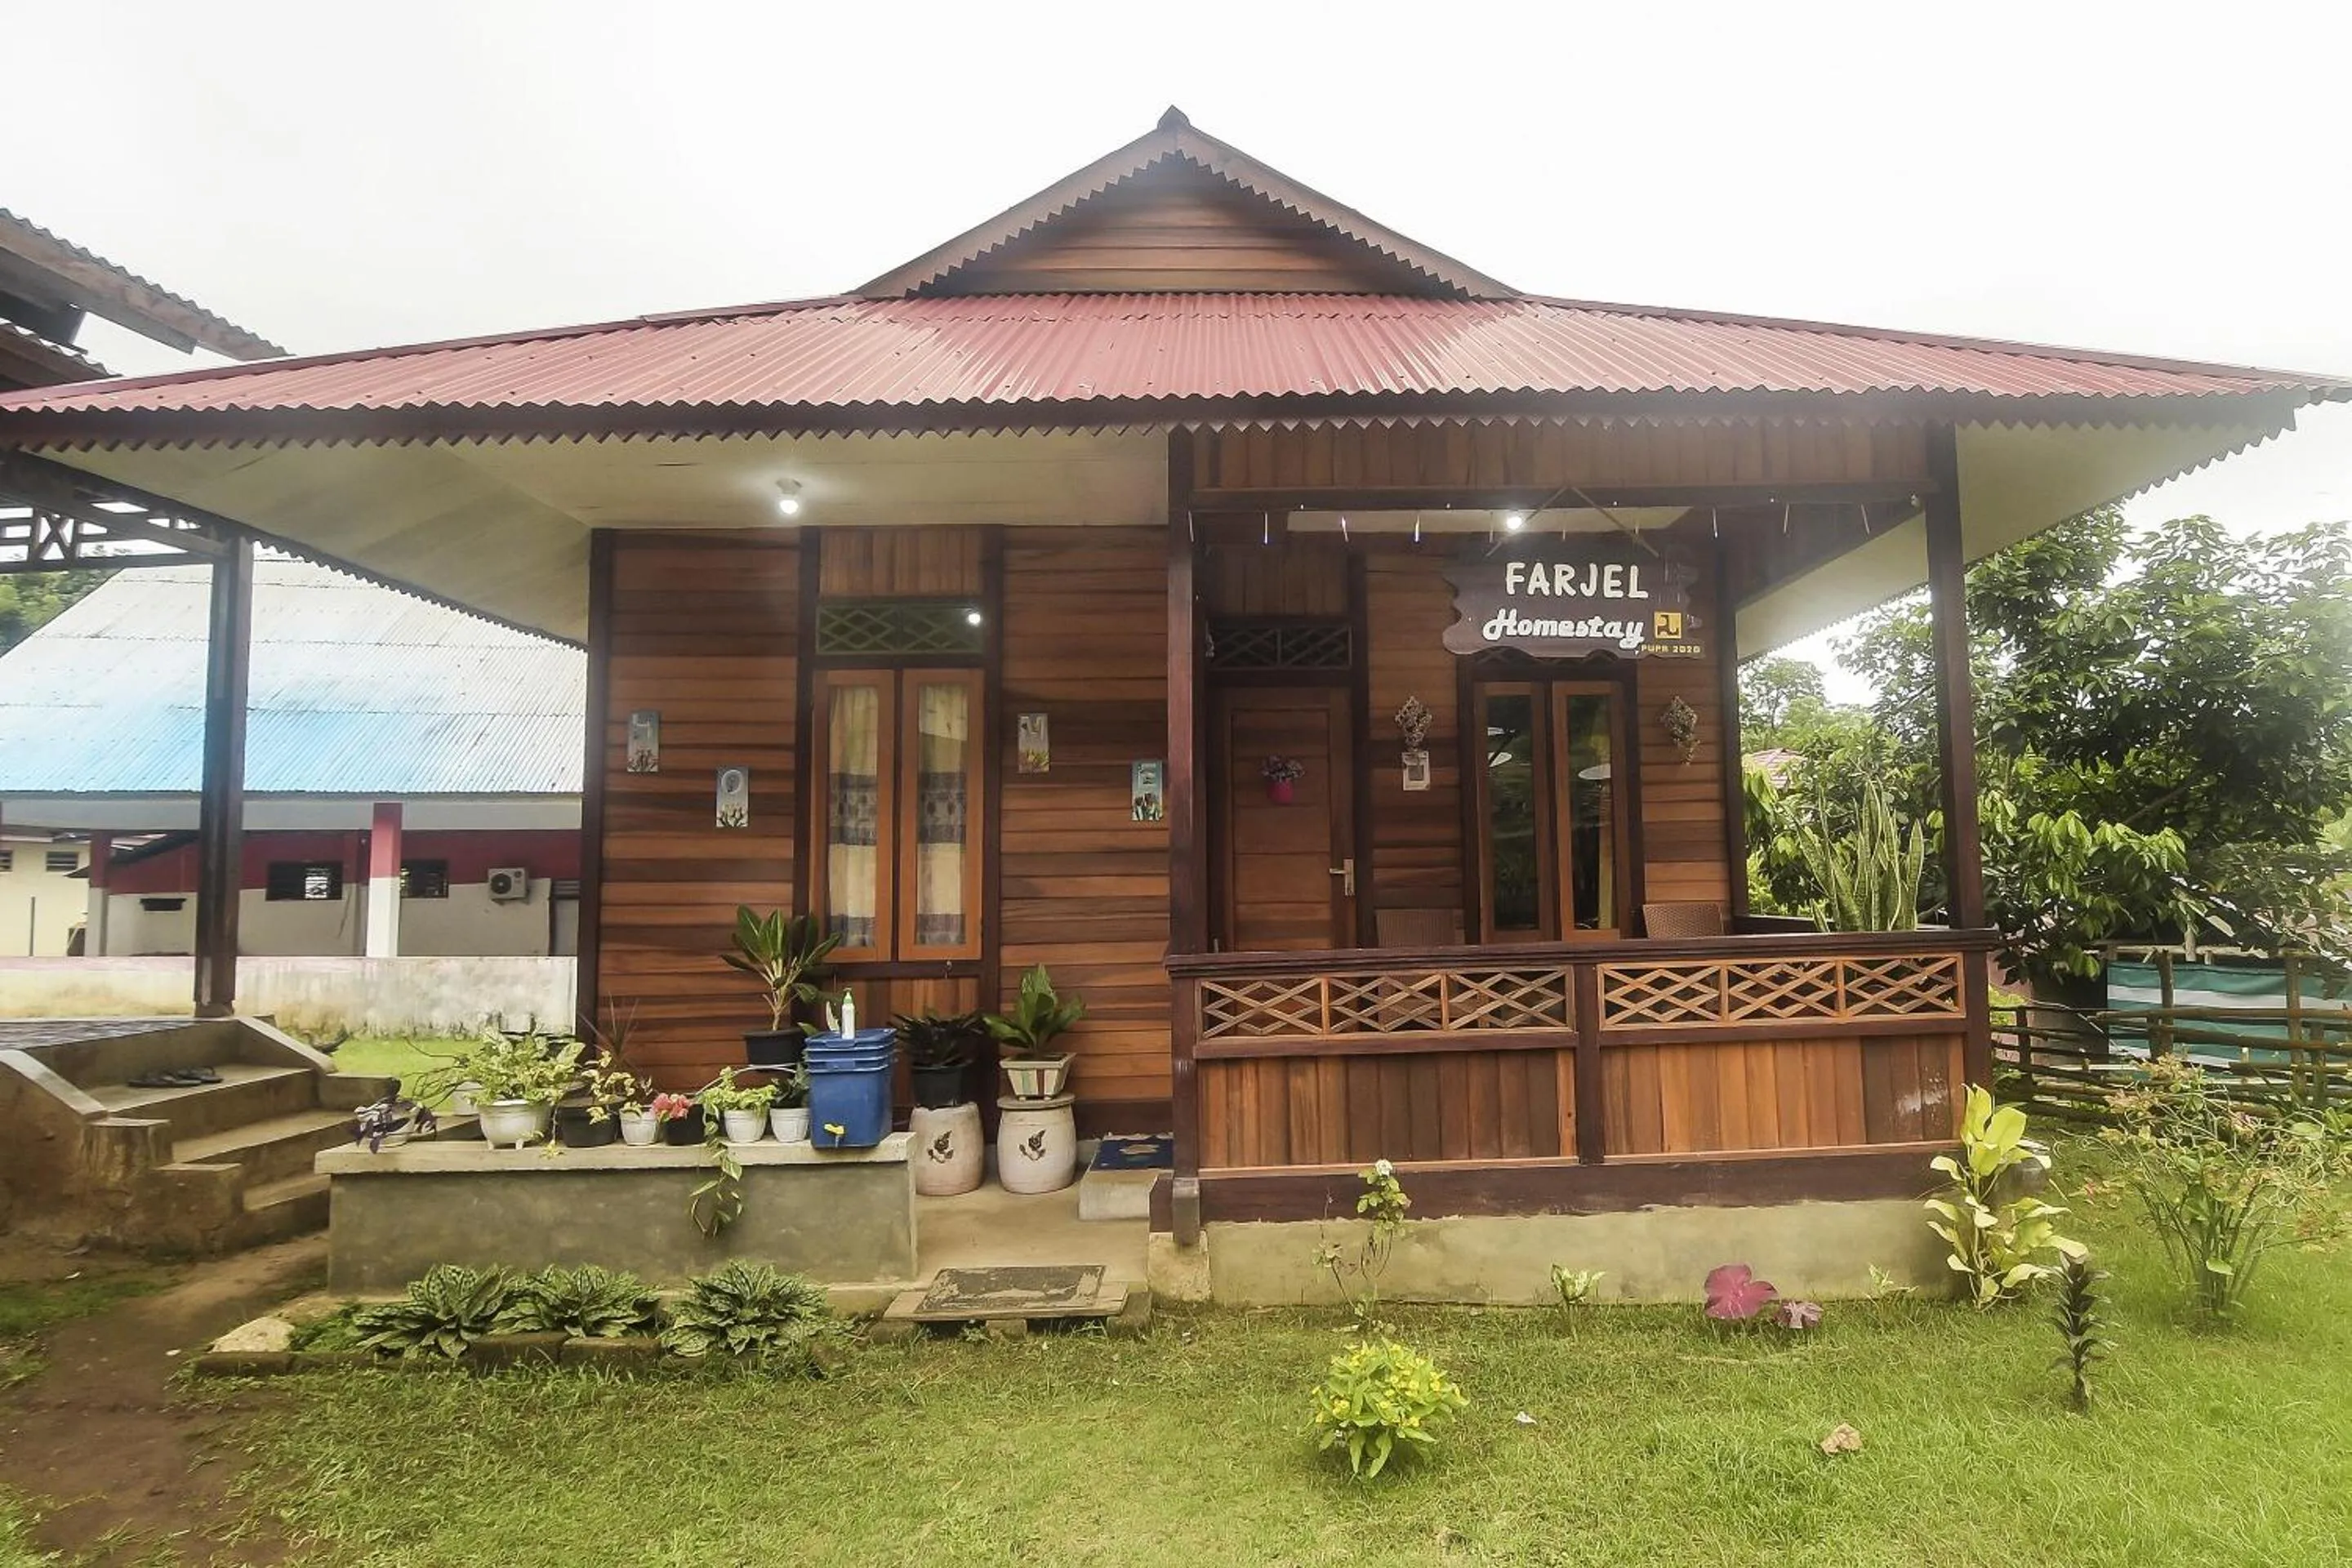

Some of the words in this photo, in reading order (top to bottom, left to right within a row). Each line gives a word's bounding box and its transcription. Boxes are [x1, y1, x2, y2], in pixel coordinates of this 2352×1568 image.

[1506, 562, 1649, 599] FARJEL
[1481, 608, 1645, 651] Homestay
[1673, 644, 1701, 654] 2020
